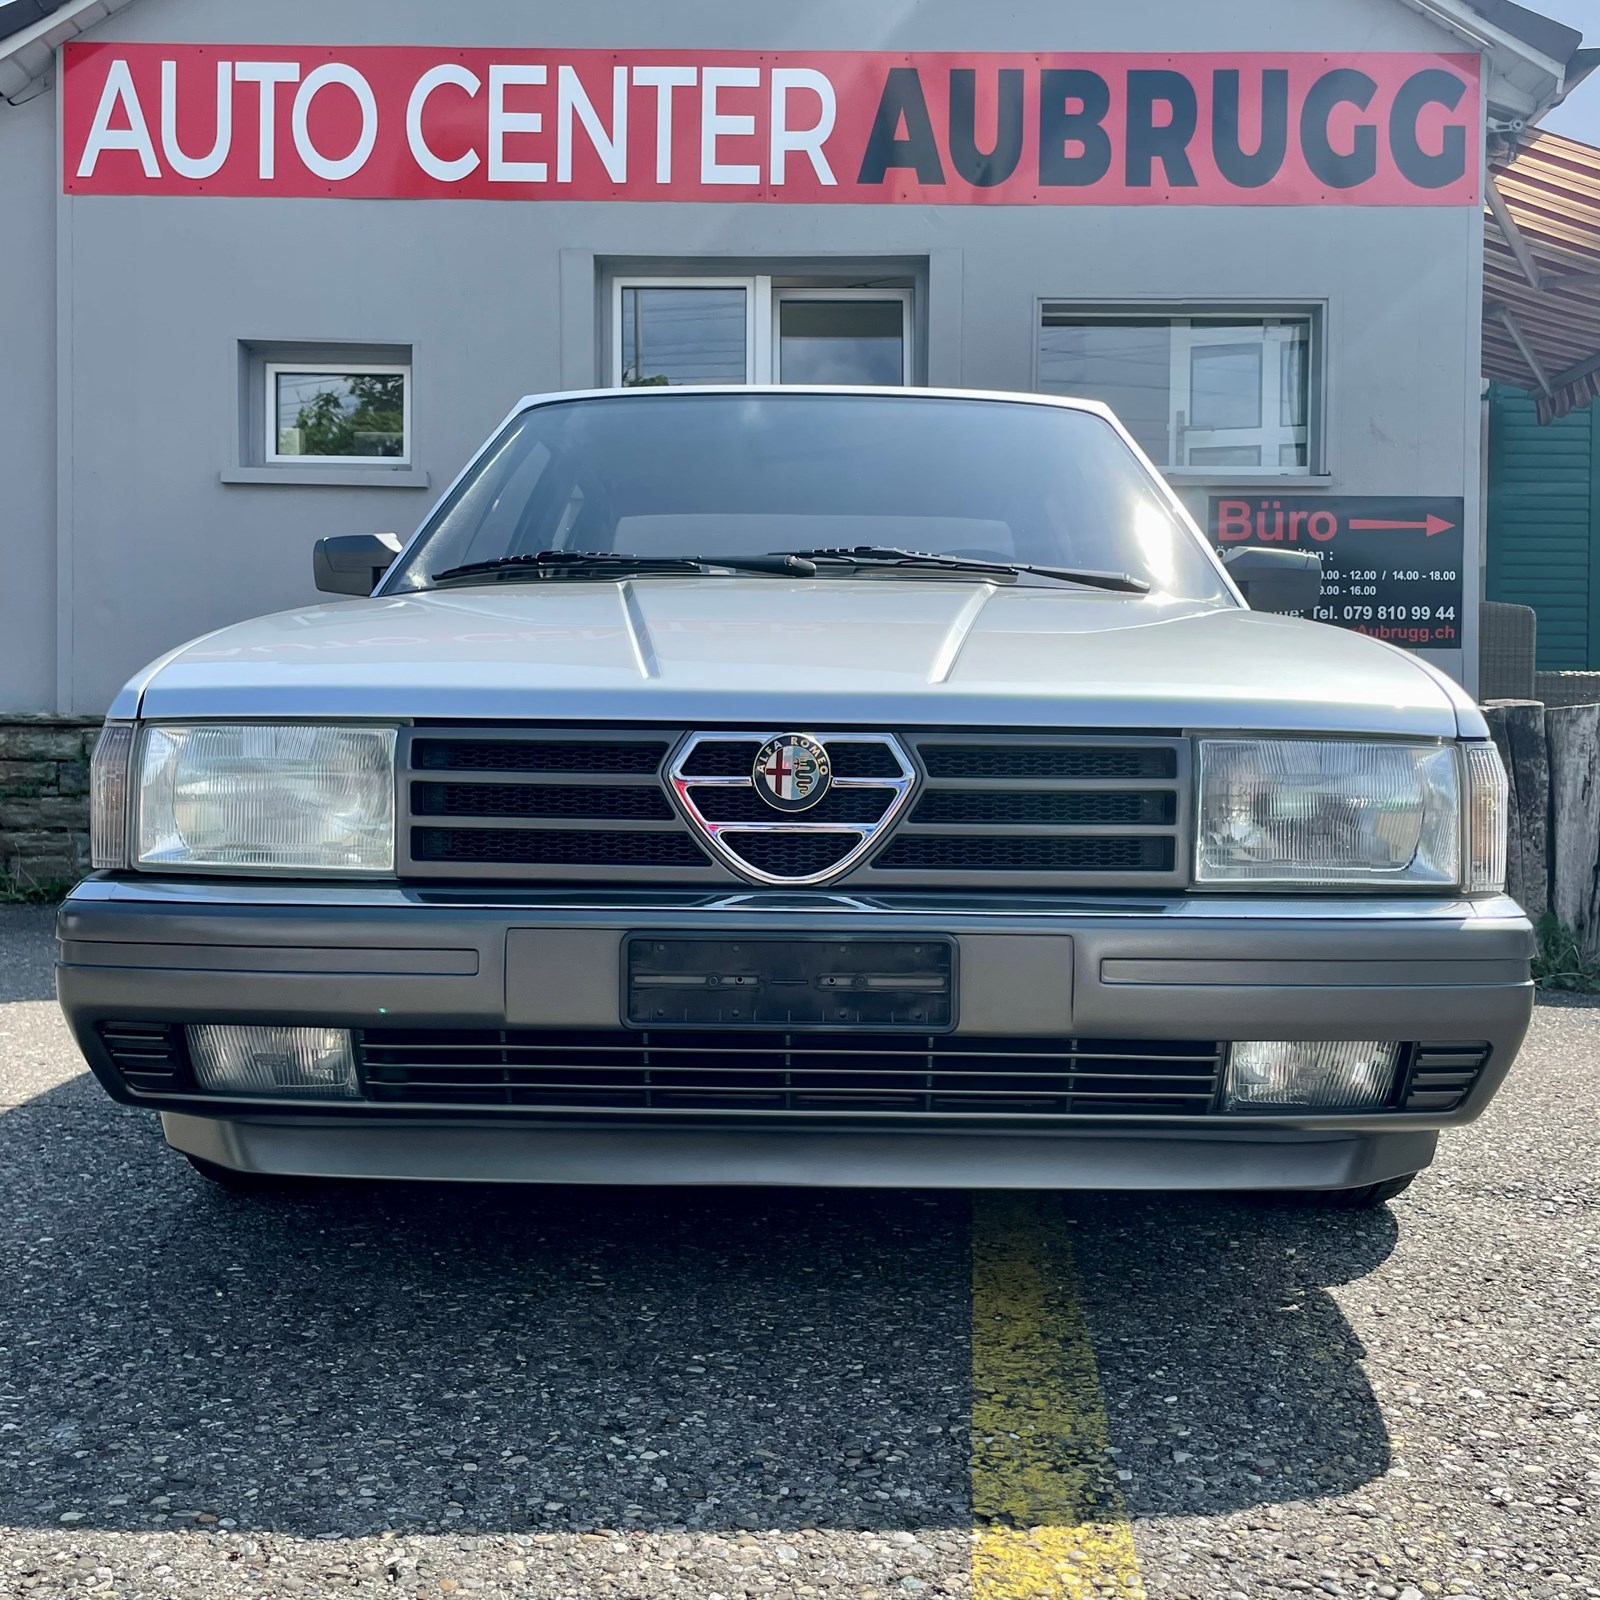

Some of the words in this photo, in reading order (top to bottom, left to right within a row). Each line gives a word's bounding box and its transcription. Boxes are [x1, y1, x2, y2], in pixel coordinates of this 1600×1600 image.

[77, 59, 378, 181] AUTO
[405, 62, 838, 186] CENTER
[855, 67, 1468, 190] AUBRUGG
[1217, 500, 1338, 542] Büro
[1349, 570, 1377, 580] 12.00
[1392, 570, 1419, 581] 14.00
[1429, 570, 1456, 581] 18.00
[1349, 585, 1377, 596] 16.00
[1343, 606, 1373, 620] 079
[1377, 606, 1407, 620] 810
[1411, 606, 1431, 620] 99
[1435, 606, 1456, 621] 44
[756, 740, 783, 774] ALFA
[790, 736, 829, 776] ROMEO
